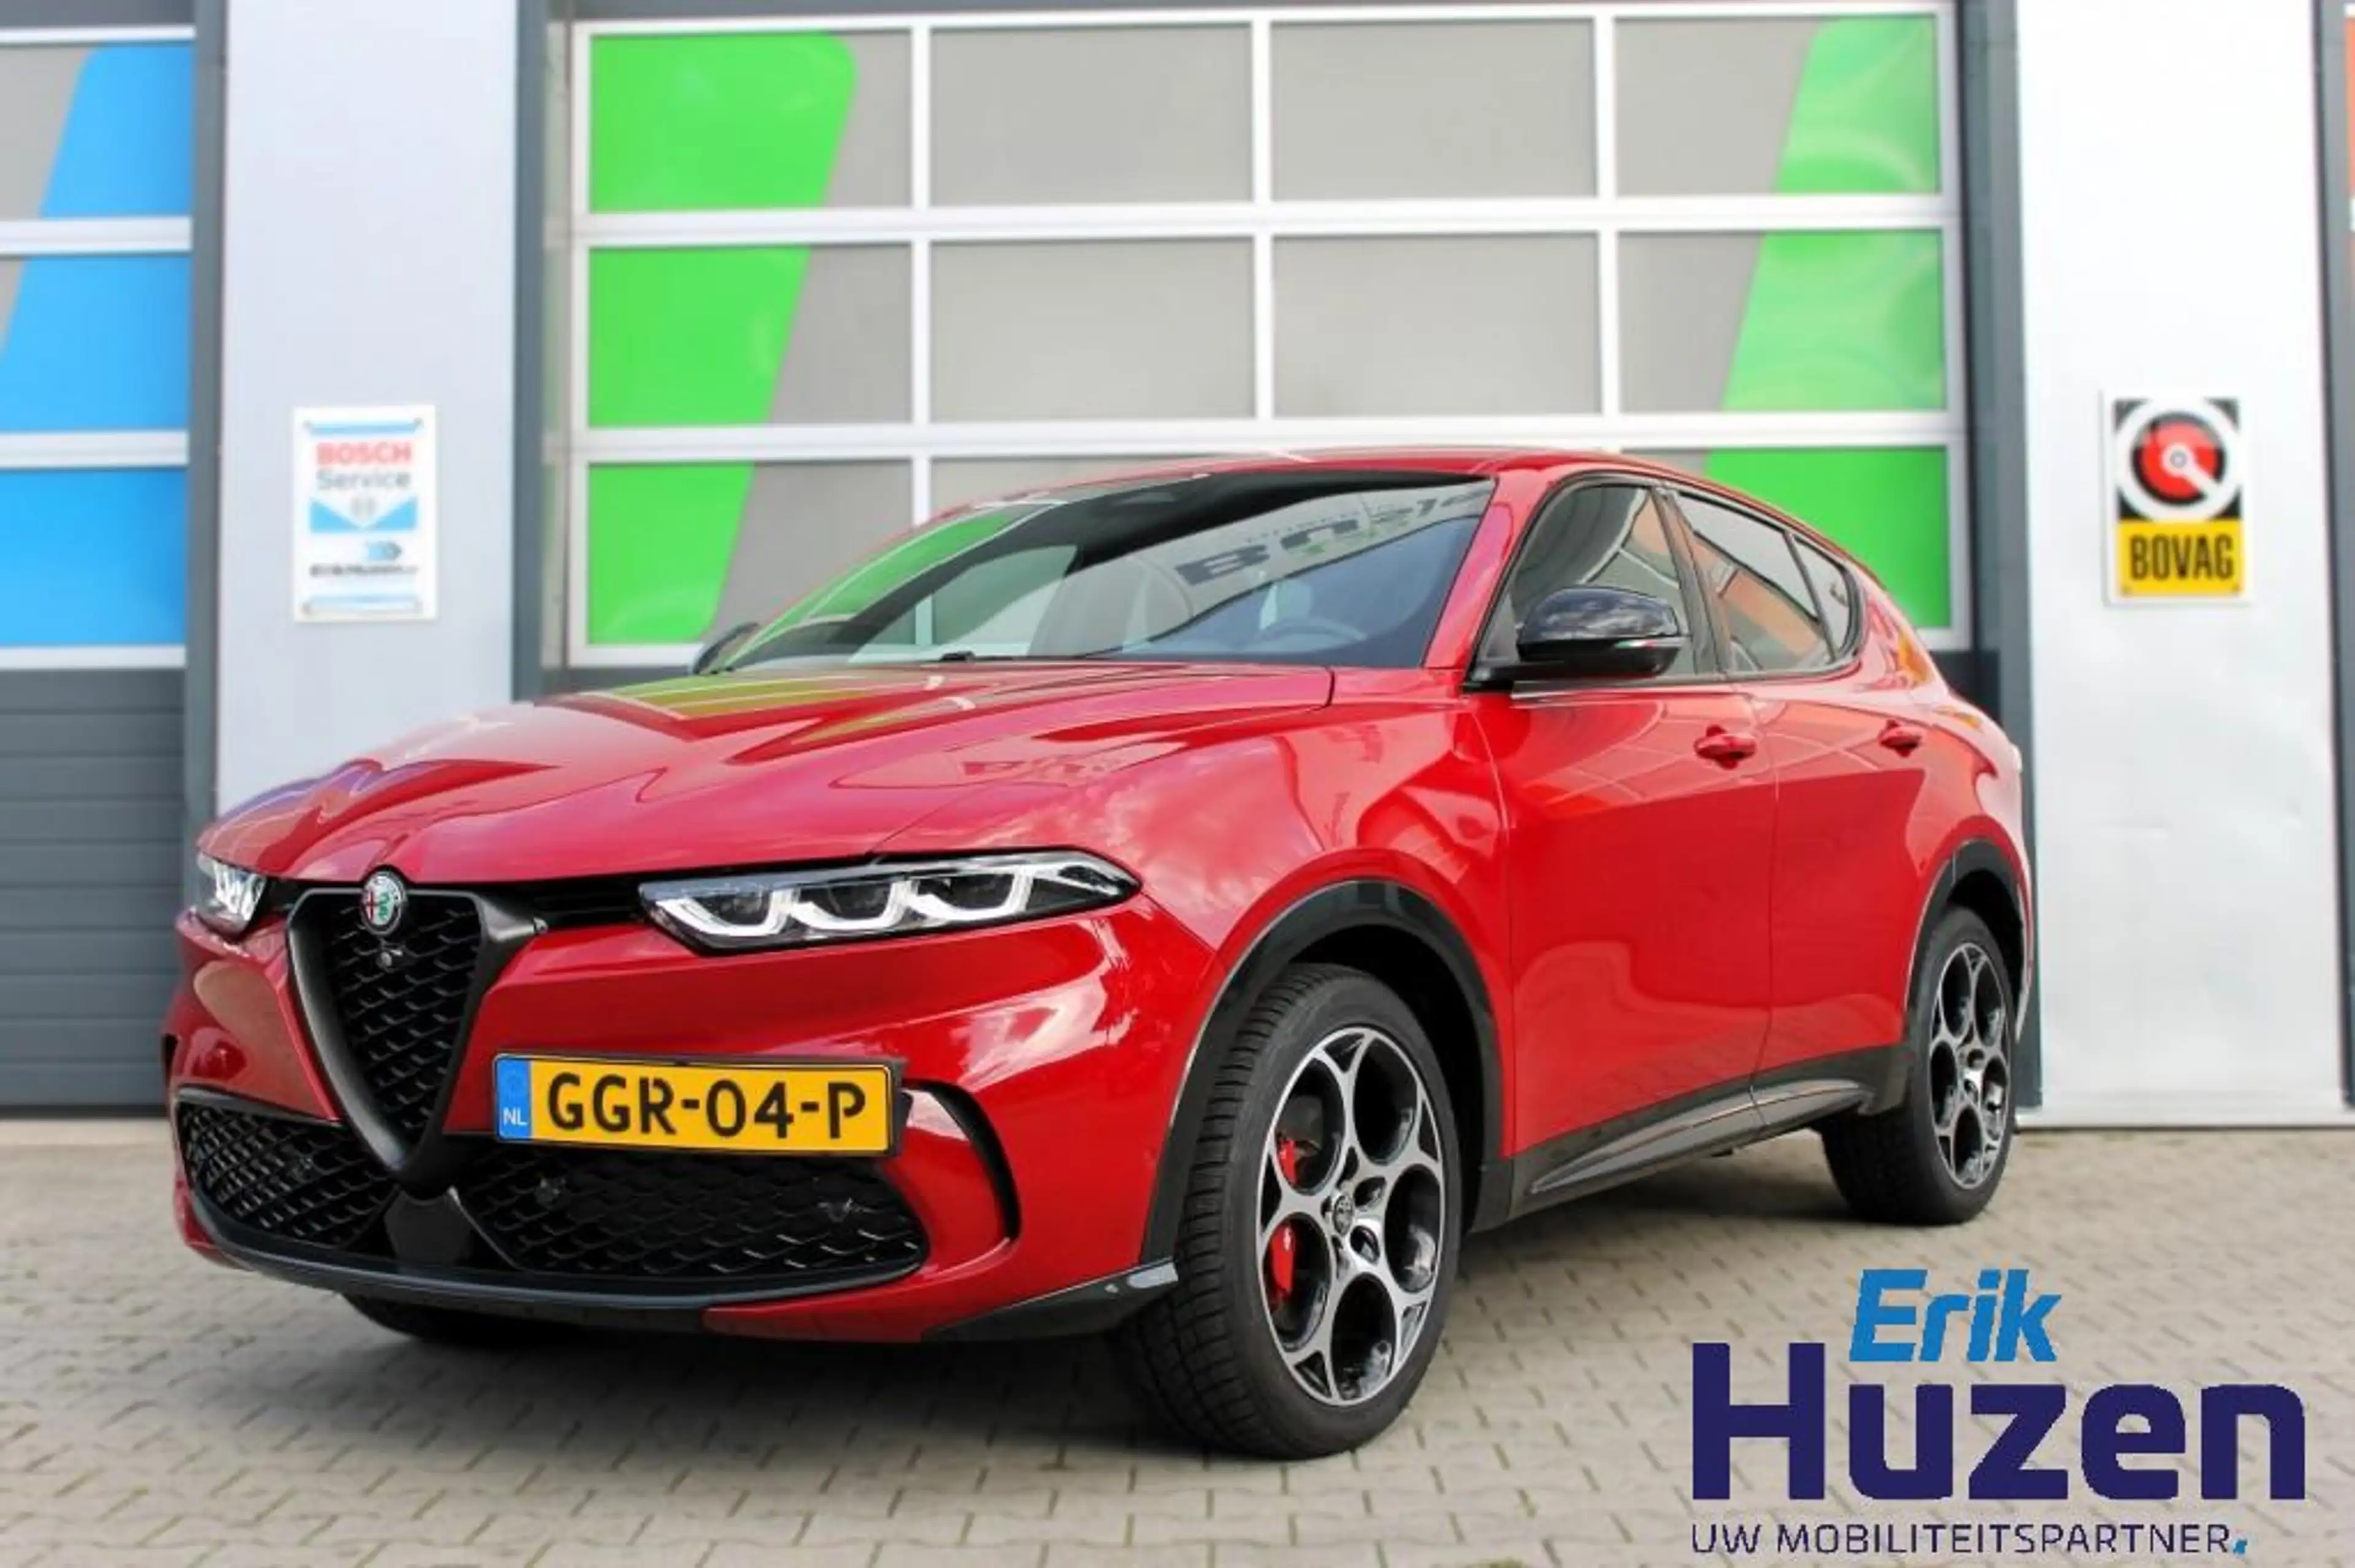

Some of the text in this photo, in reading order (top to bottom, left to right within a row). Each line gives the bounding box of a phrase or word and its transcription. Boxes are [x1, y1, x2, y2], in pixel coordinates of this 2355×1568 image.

[316, 442, 412, 465] BOSCH
[316, 468, 411, 489] Service
[2129, 534, 2234, 581] BOVAG
[503, 1106, 528, 1126] NL
[547, 1072, 866, 1139] GGR-04-P
